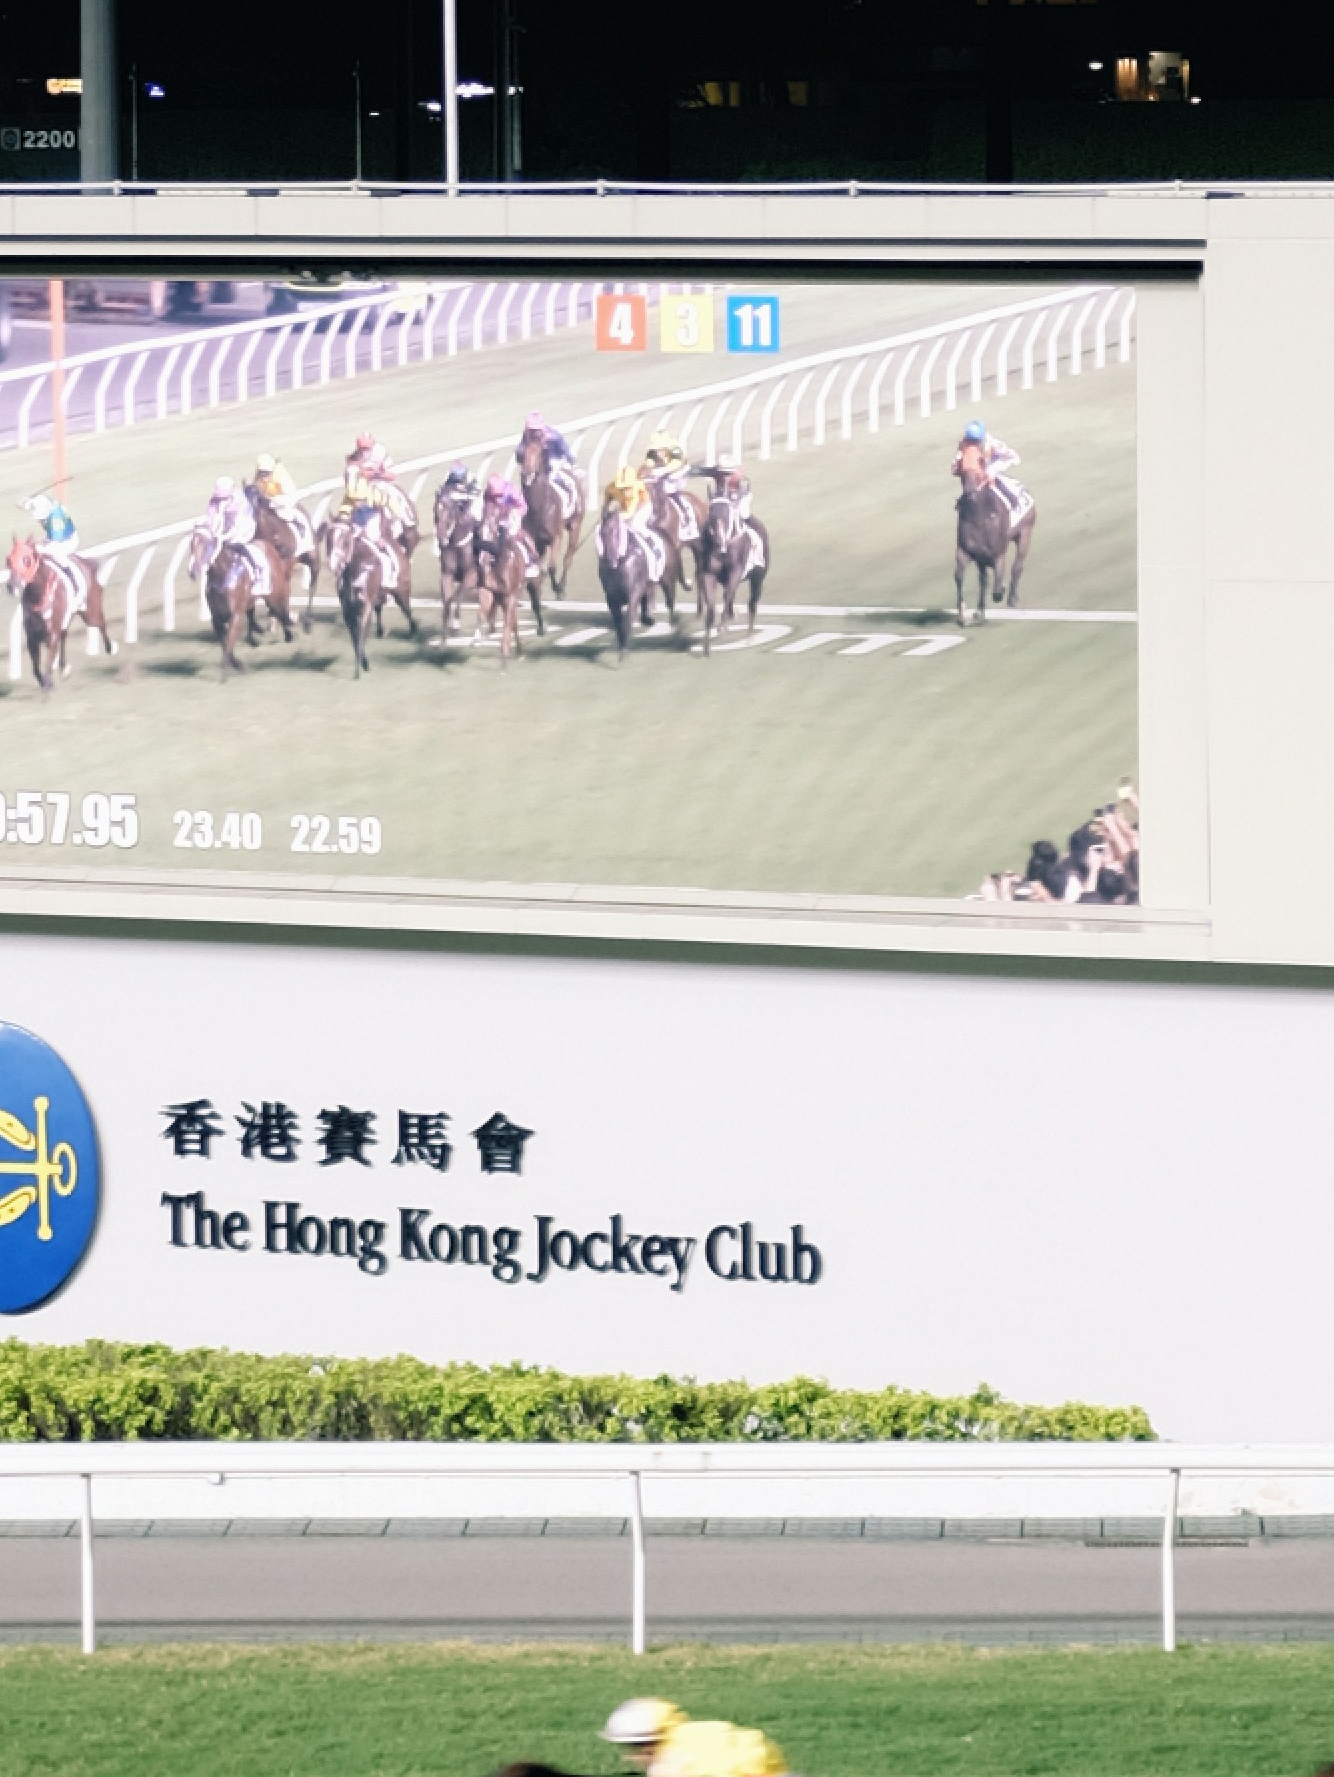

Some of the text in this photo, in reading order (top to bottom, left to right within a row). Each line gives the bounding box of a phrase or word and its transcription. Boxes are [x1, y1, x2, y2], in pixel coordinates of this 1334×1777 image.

[24, 130, 76, 148] 2200
[608, 302, 636, 346] 4
[734, 302, 772, 348] 11
[173, 809, 262, 850] 23.40
[290, 813, 382, 855] 22.59
[161, 1099, 535, 1175] 香港賽馬會
[160, 1190, 822, 1292] The Hong Kong Jockey Club
